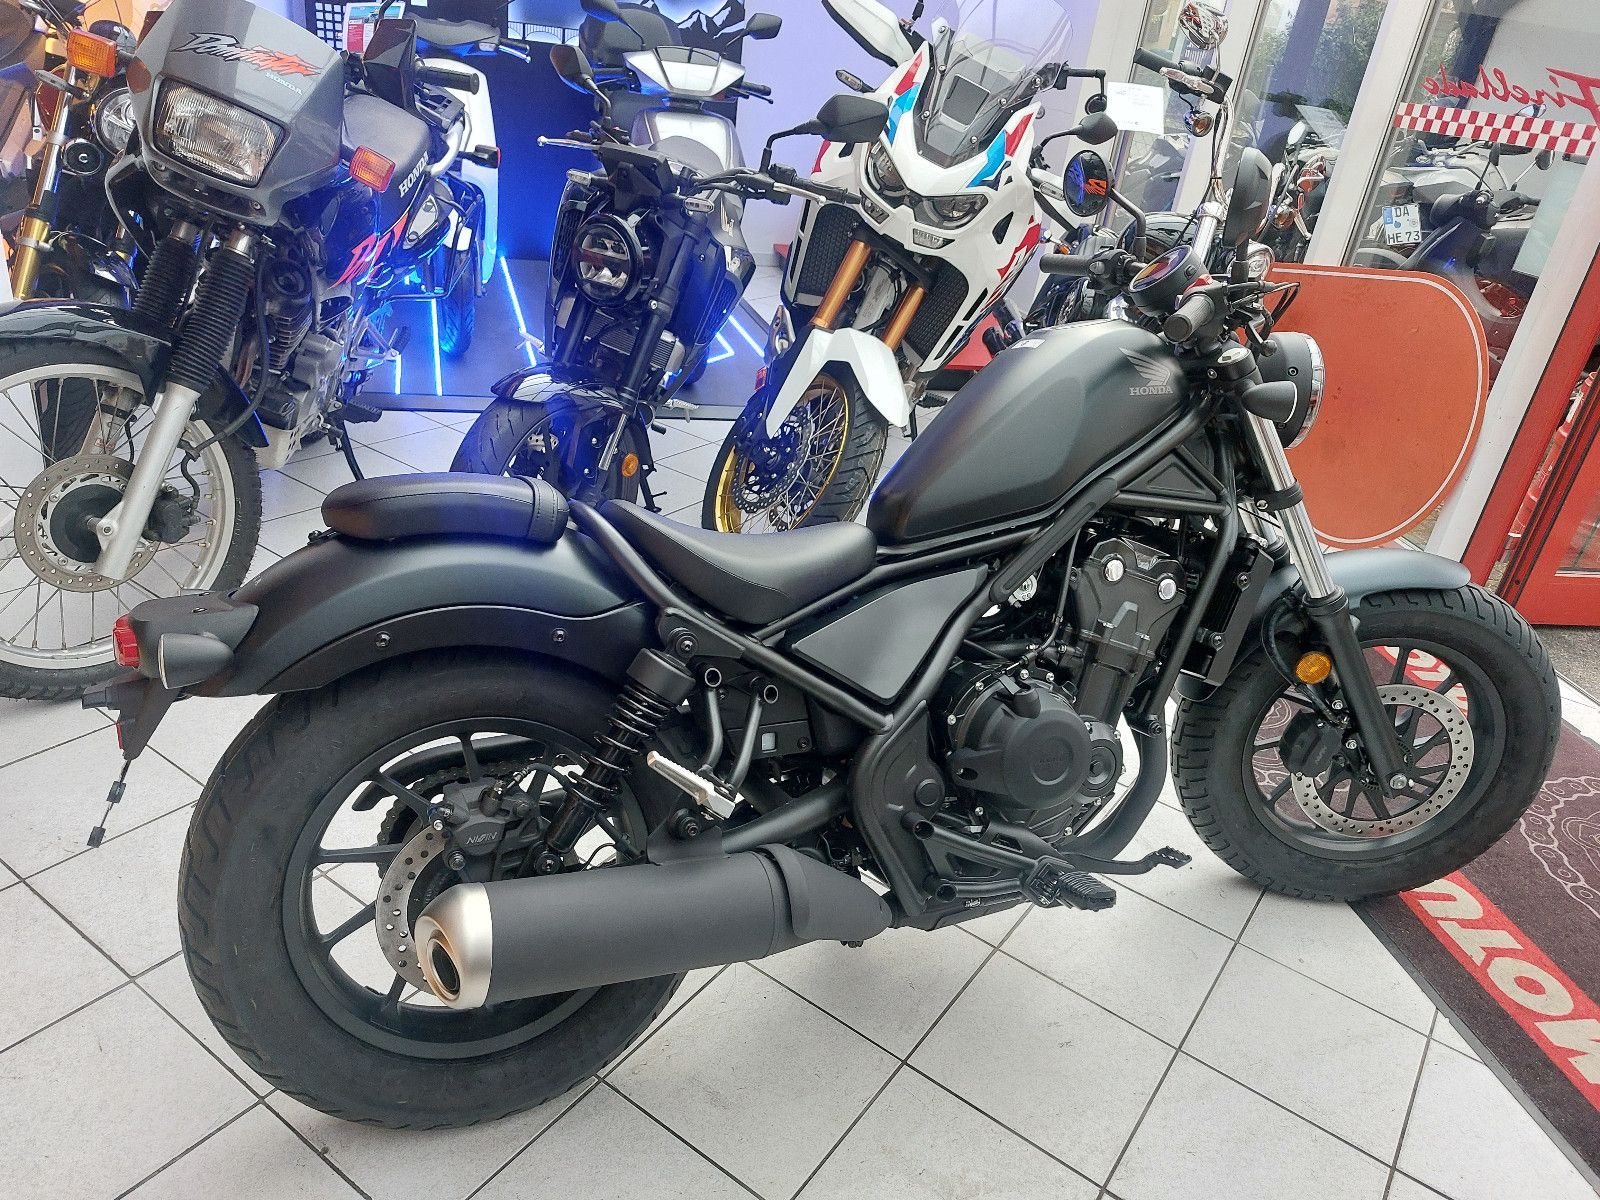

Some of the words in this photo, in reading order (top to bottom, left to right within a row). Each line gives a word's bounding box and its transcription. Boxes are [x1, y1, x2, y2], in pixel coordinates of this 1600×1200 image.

[398, 151, 429, 198] HONDA
[1394, 206, 1410, 217] DA
[1388, 233, 1403, 244] HE
[1406, 231, 1420, 241] 73
[1129, 386, 1173, 396] HONDA
[1411, 878, 1600, 1085] MOTU
